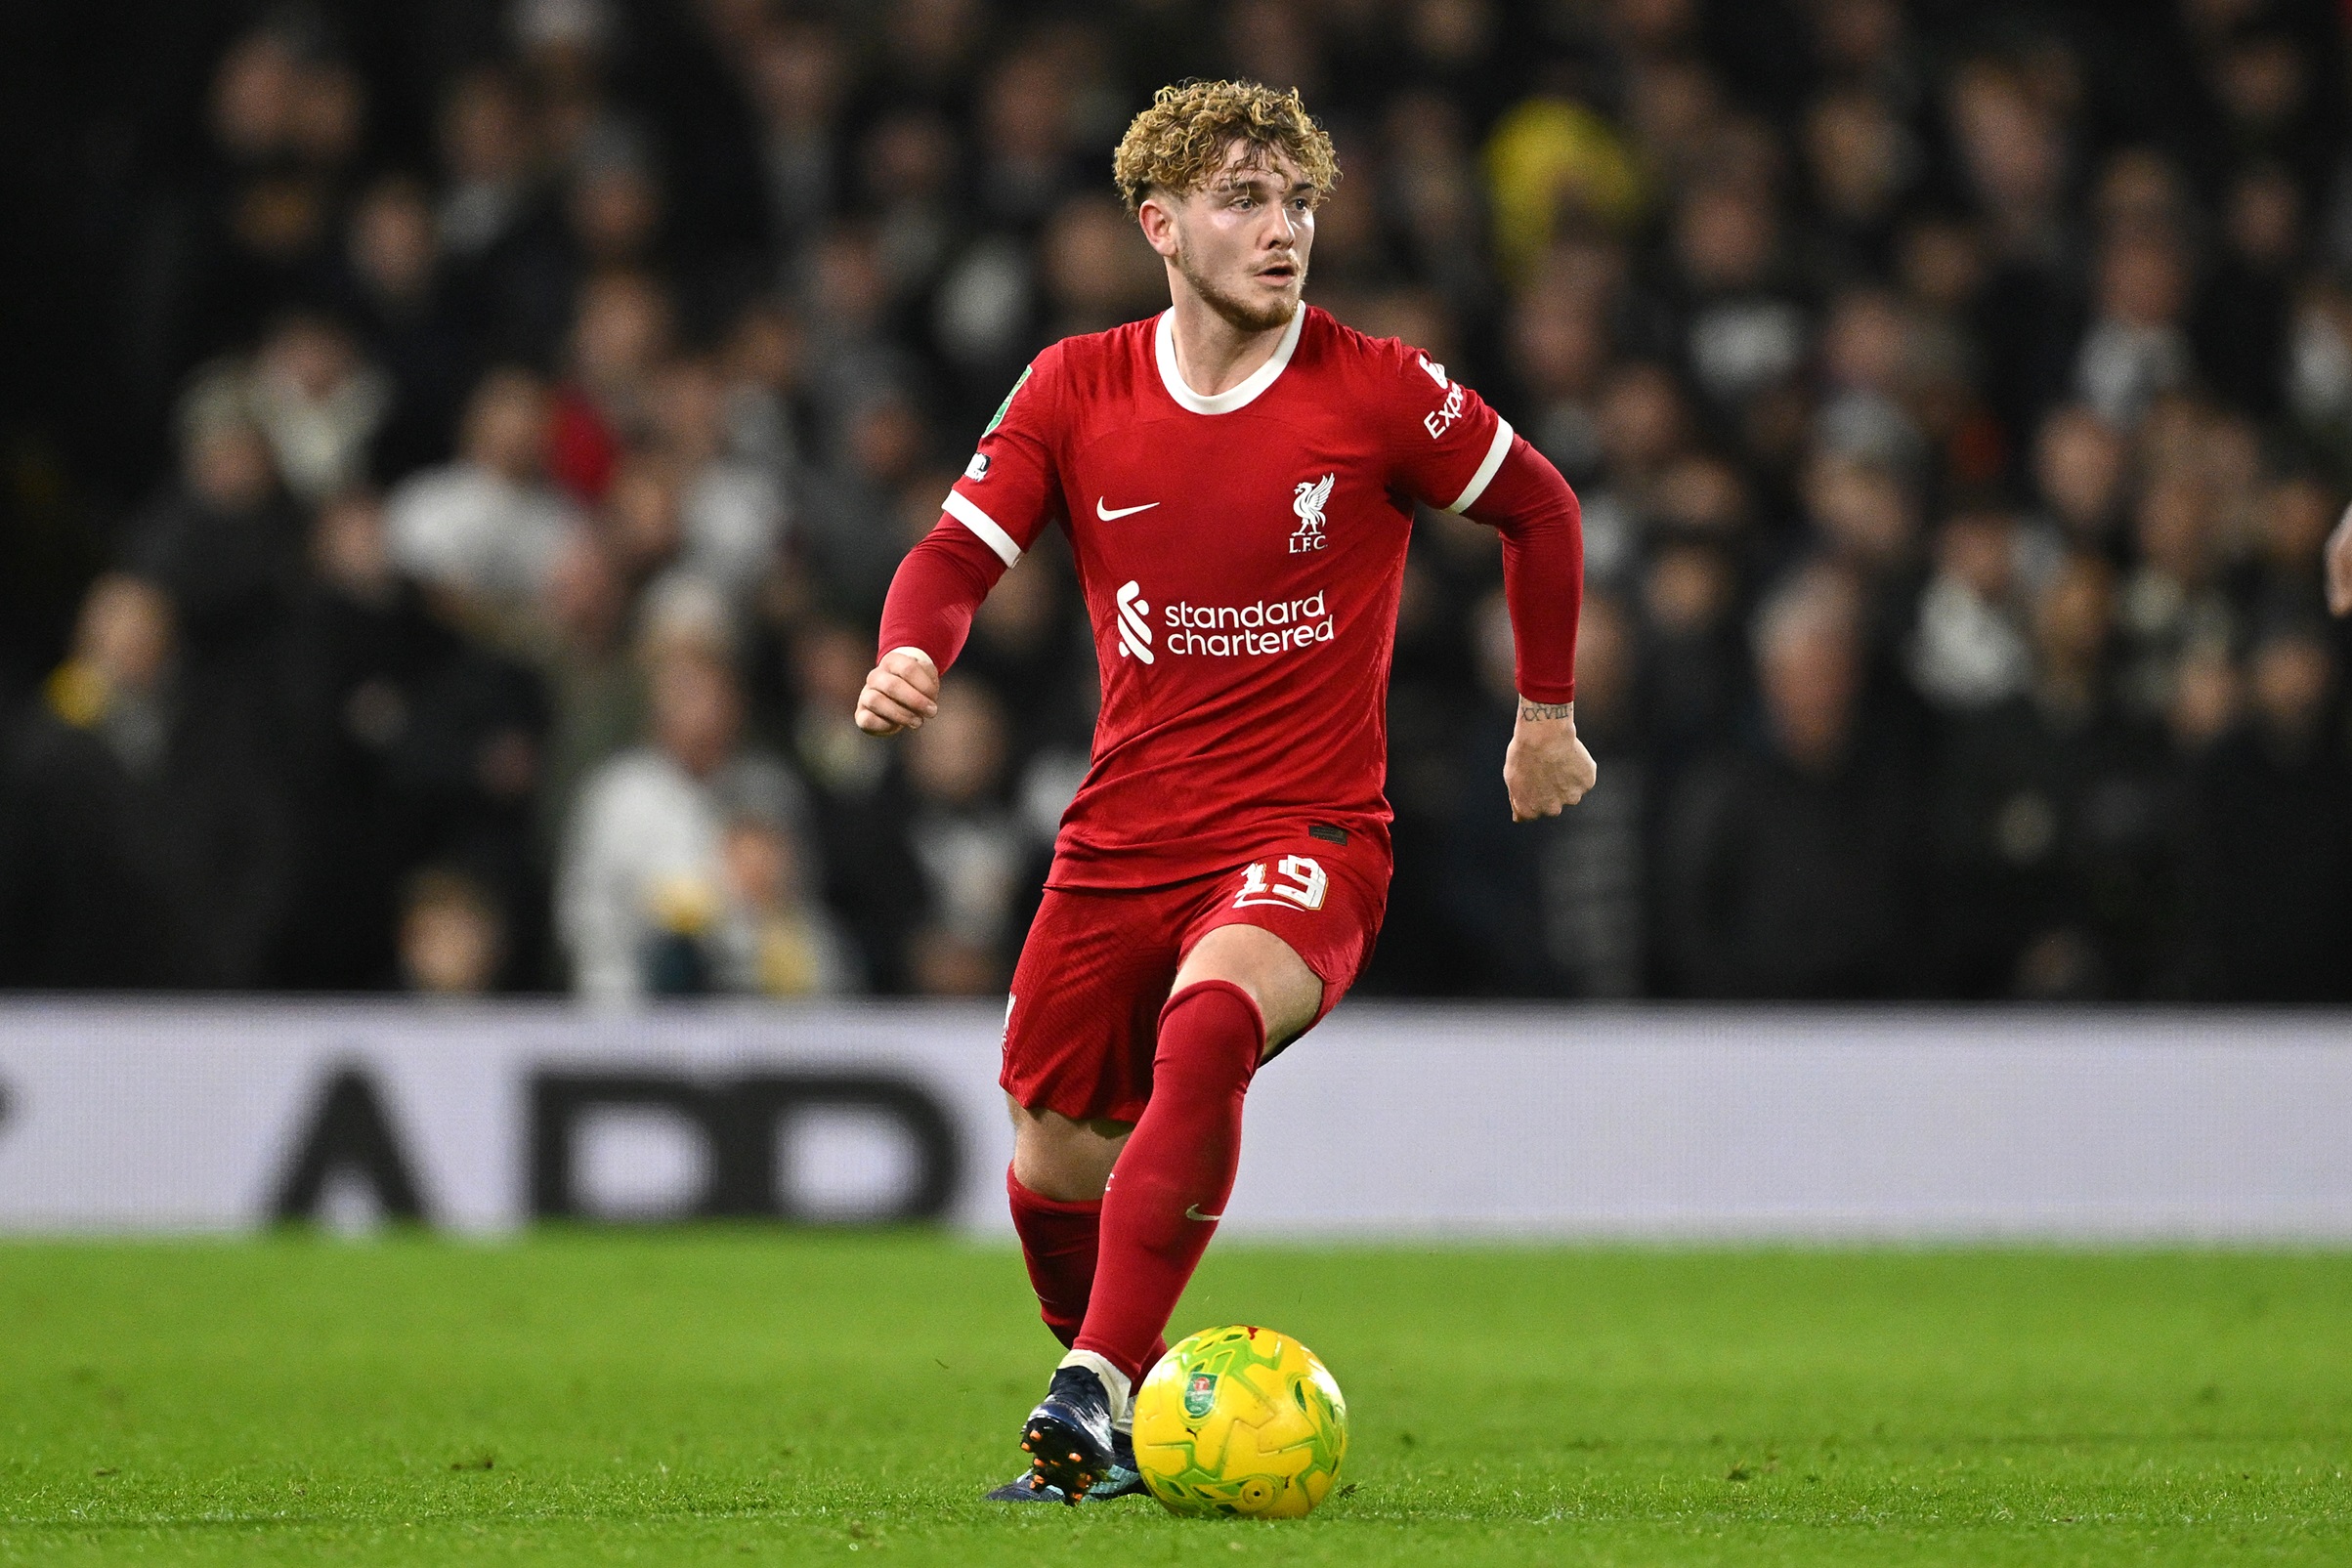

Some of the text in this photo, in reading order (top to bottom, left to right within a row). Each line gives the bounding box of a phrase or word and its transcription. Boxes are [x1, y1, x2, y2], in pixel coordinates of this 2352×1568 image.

[1165, 589, 1326, 629] standard
[1167, 616, 1335, 657] chartered
[1234, 854, 1329, 911] 19
